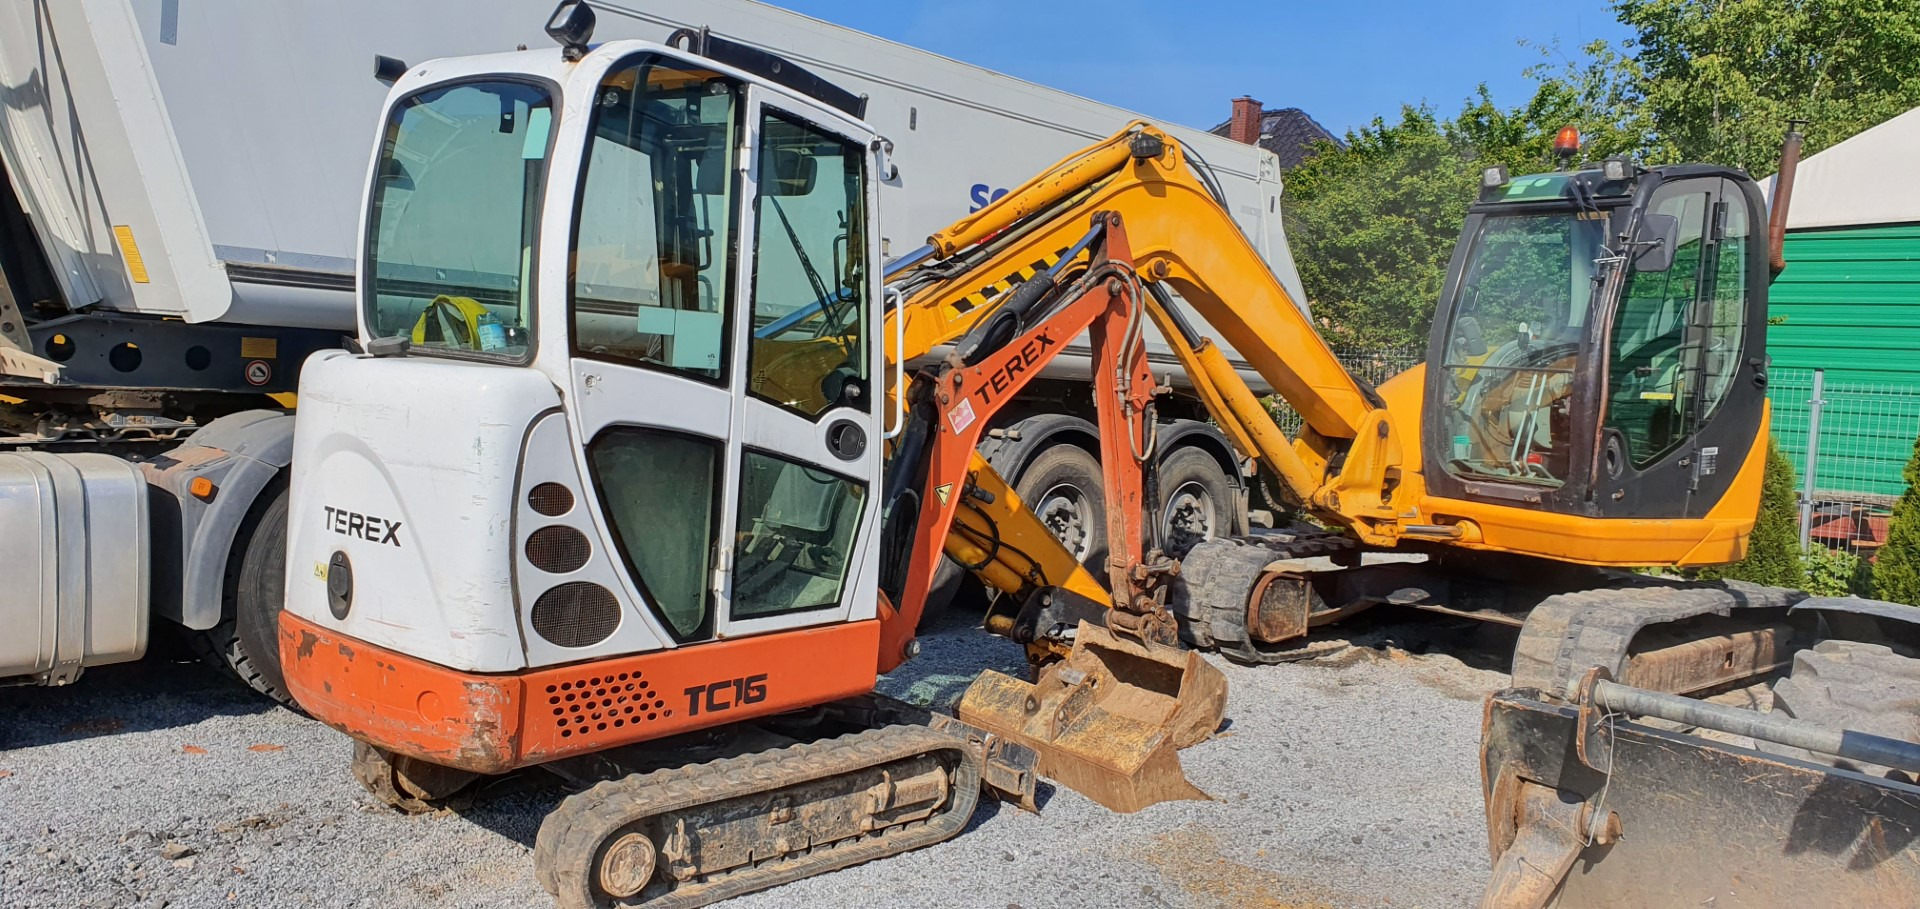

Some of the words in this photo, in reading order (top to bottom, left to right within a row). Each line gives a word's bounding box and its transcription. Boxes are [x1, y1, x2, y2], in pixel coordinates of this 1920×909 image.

[974, 326, 1055, 405] TEREX
[324, 505, 402, 547] TEREX
[684, 673, 768, 716] TC16
